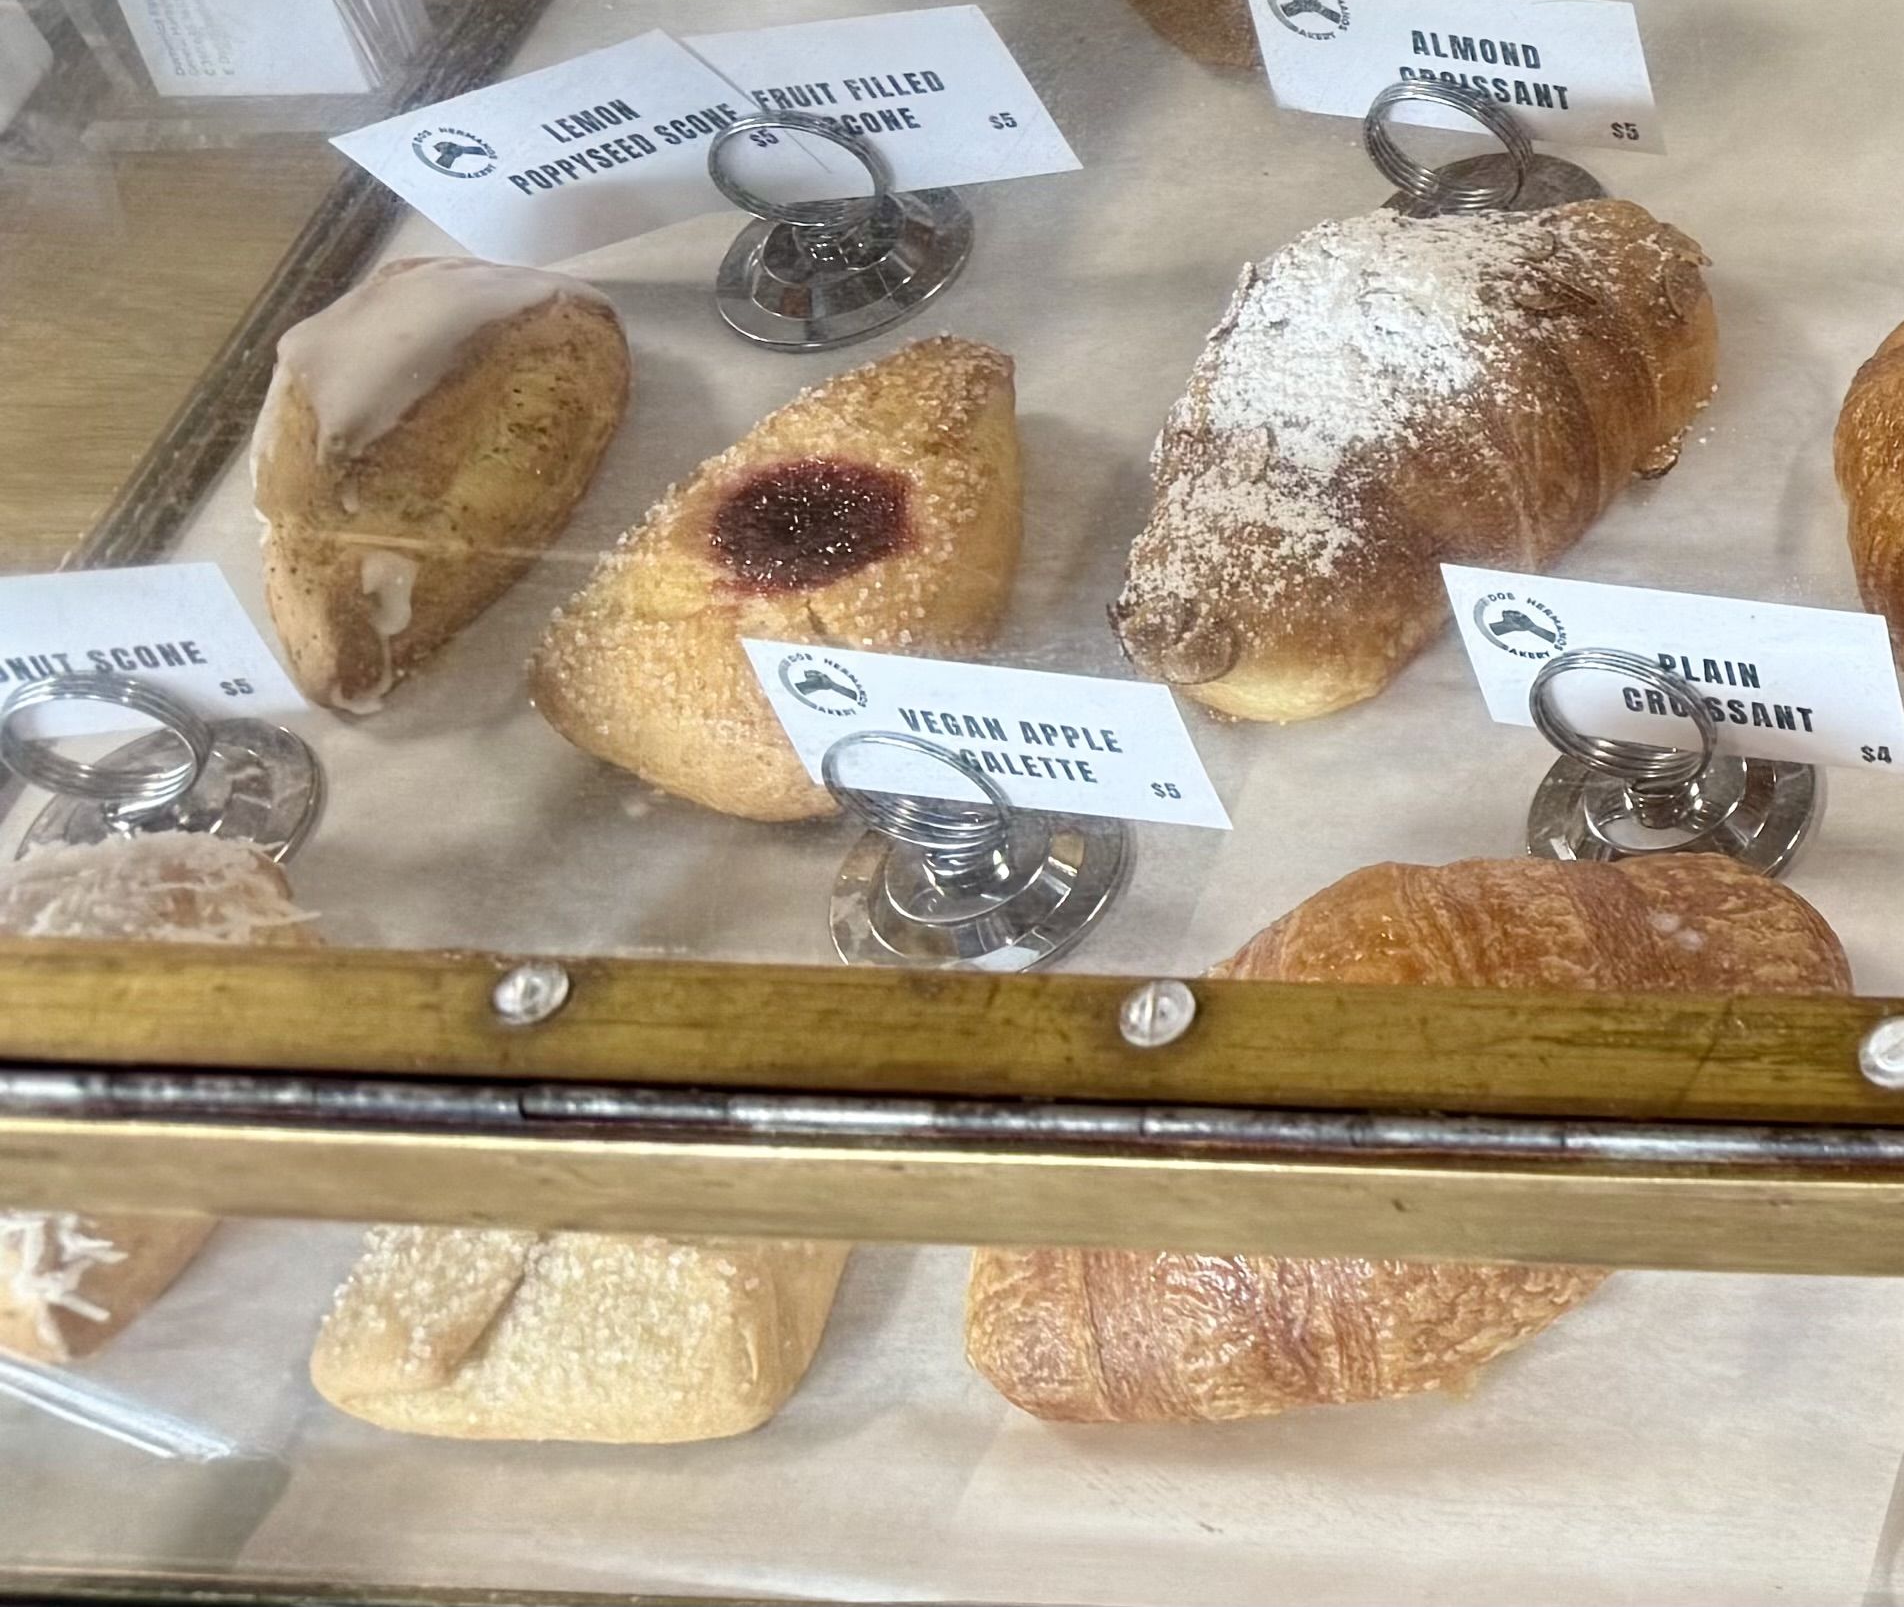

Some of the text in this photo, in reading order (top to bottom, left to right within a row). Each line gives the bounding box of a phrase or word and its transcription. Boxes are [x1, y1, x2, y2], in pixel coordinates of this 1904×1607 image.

[1411, 30, 1541, 70] ALMOND
[751, 70, 946, 111] FRUIT FILLED
[541, 99, 641, 144] LEMON
[749, 127, 779, 148] $5
[987, 112, 1018, 130] $5
[1611, 122, 1640, 141] $5
[508, 102, 739, 196] POPPYSEED SCONE
[87, 641, 207, 675] SCONE
[1657, 652, 1762, 690] PLAIN
[219, 678, 254, 696] $5
[1622, 686, 1816, 733] CROSSANT
[898, 707, 1123, 754] VEGAN APPLE
[959, 747, 1098, 784] GALETTE
[1859, 745, 1893, 764] $4
[1150, 782, 1182, 800] $5
